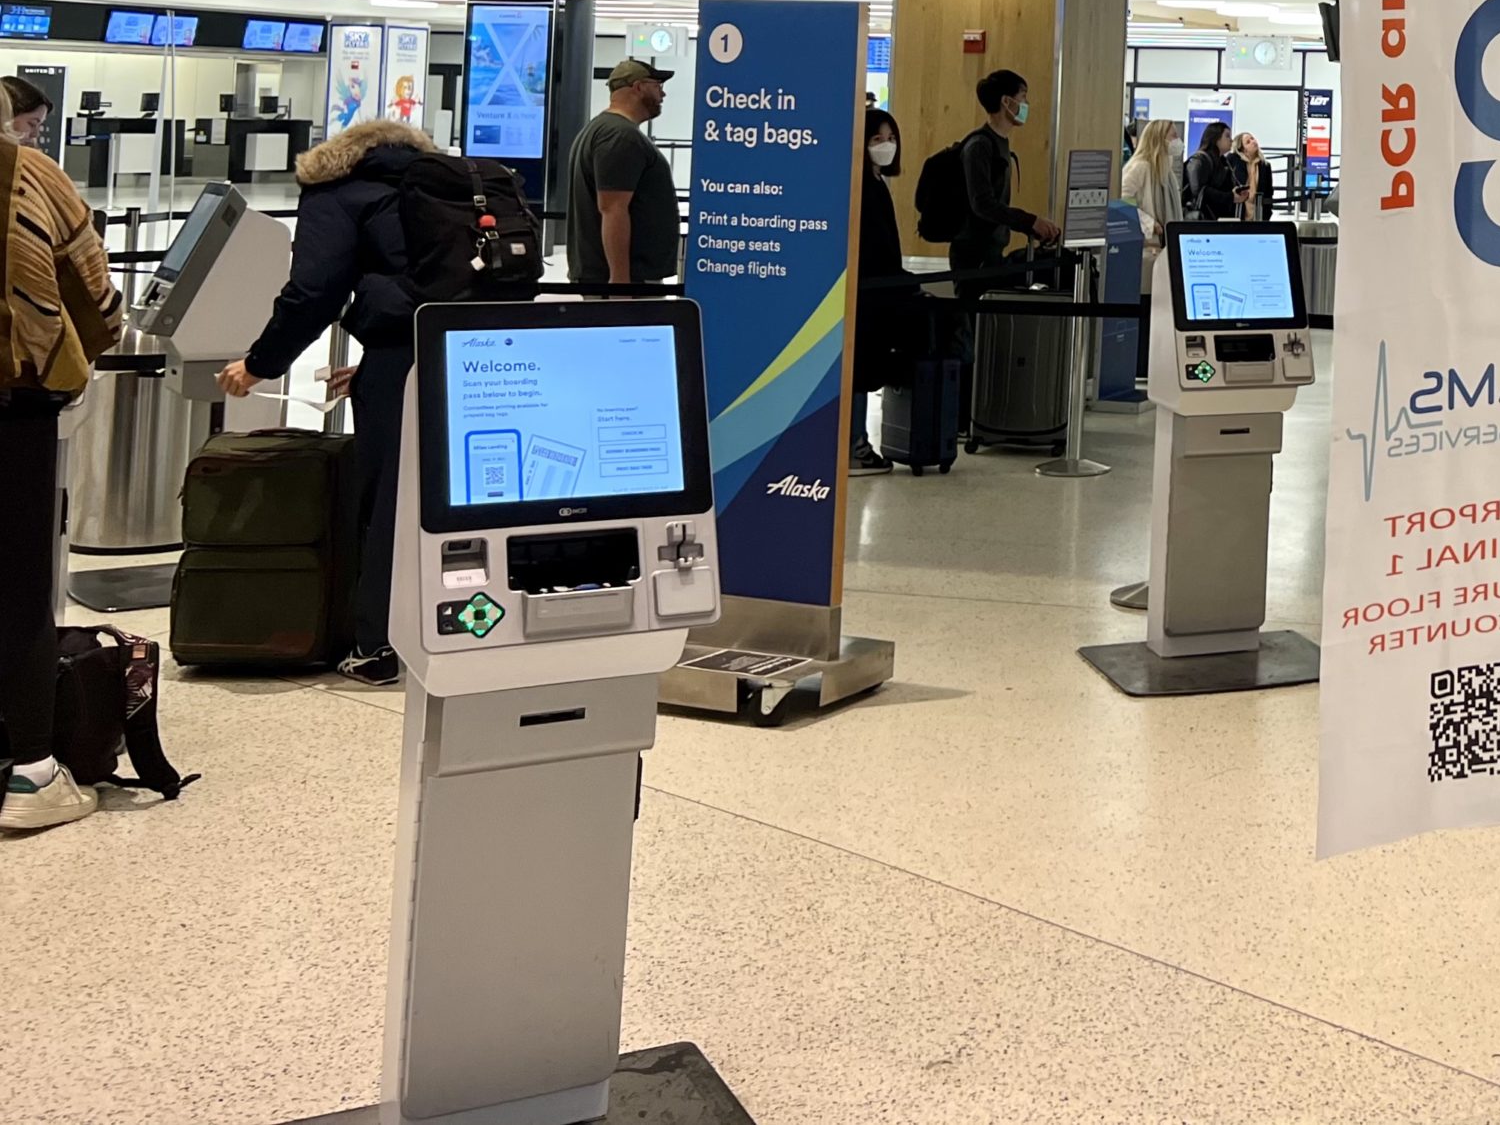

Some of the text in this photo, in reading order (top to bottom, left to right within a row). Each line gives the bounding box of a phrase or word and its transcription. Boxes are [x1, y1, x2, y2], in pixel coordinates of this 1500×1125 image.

[721, 34, 728, 52] 1
[706, 86, 795, 110] Check in
[705, 120, 818, 149] & tag bags.
[701, 179, 783, 195] You can also:
[699, 212, 827, 232] Print a boarding pass
[698, 235, 780, 252] Change seats
[697, 259, 786, 278] Change flights
[463, 360, 540, 372] Welcome.
[766, 475, 830, 502] Alaska
